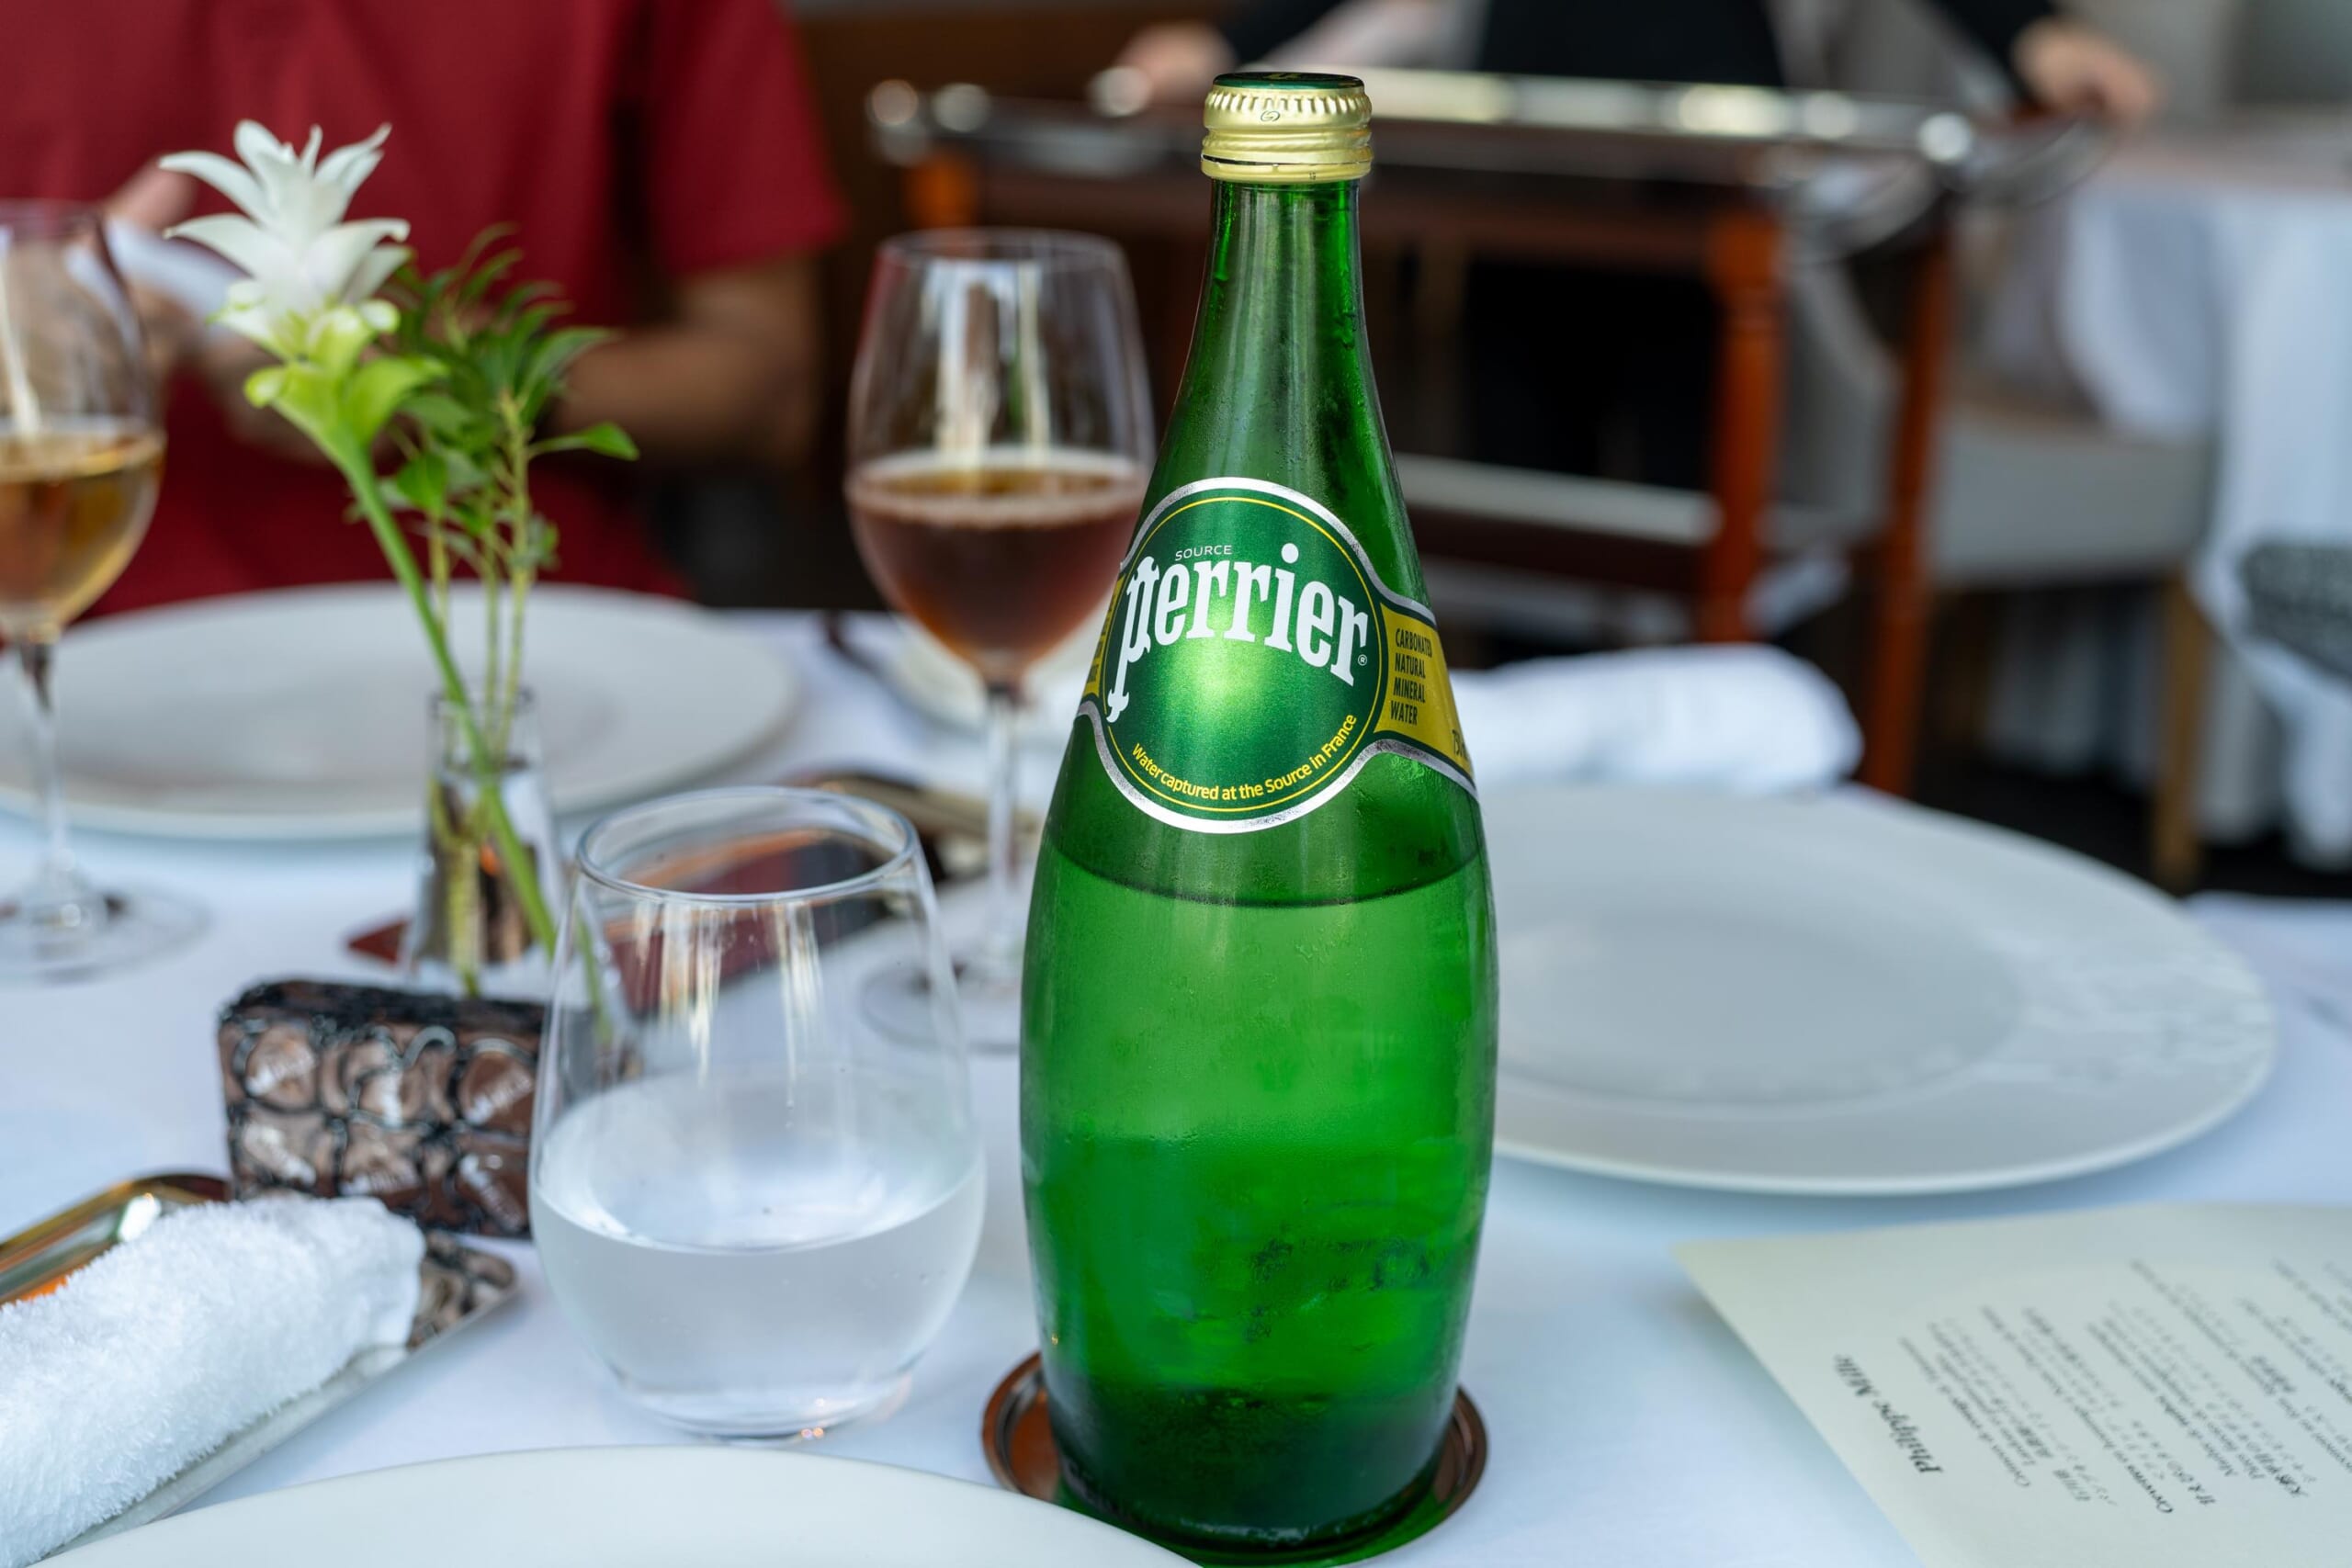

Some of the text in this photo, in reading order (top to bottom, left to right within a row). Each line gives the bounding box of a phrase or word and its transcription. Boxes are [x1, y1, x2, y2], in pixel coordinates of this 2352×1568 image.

[1175, 545, 1233, 560] SOURCE
[1395, 628, 1432, 659] CARBONATED
[1395, 653, 1426, 679] NATURAL
[1393, 677, 1426, 704] MINERAL
[1390, 700, 1419, 725] WATER
[1132, 714, 1357, 800] Water captured at the Source in France
